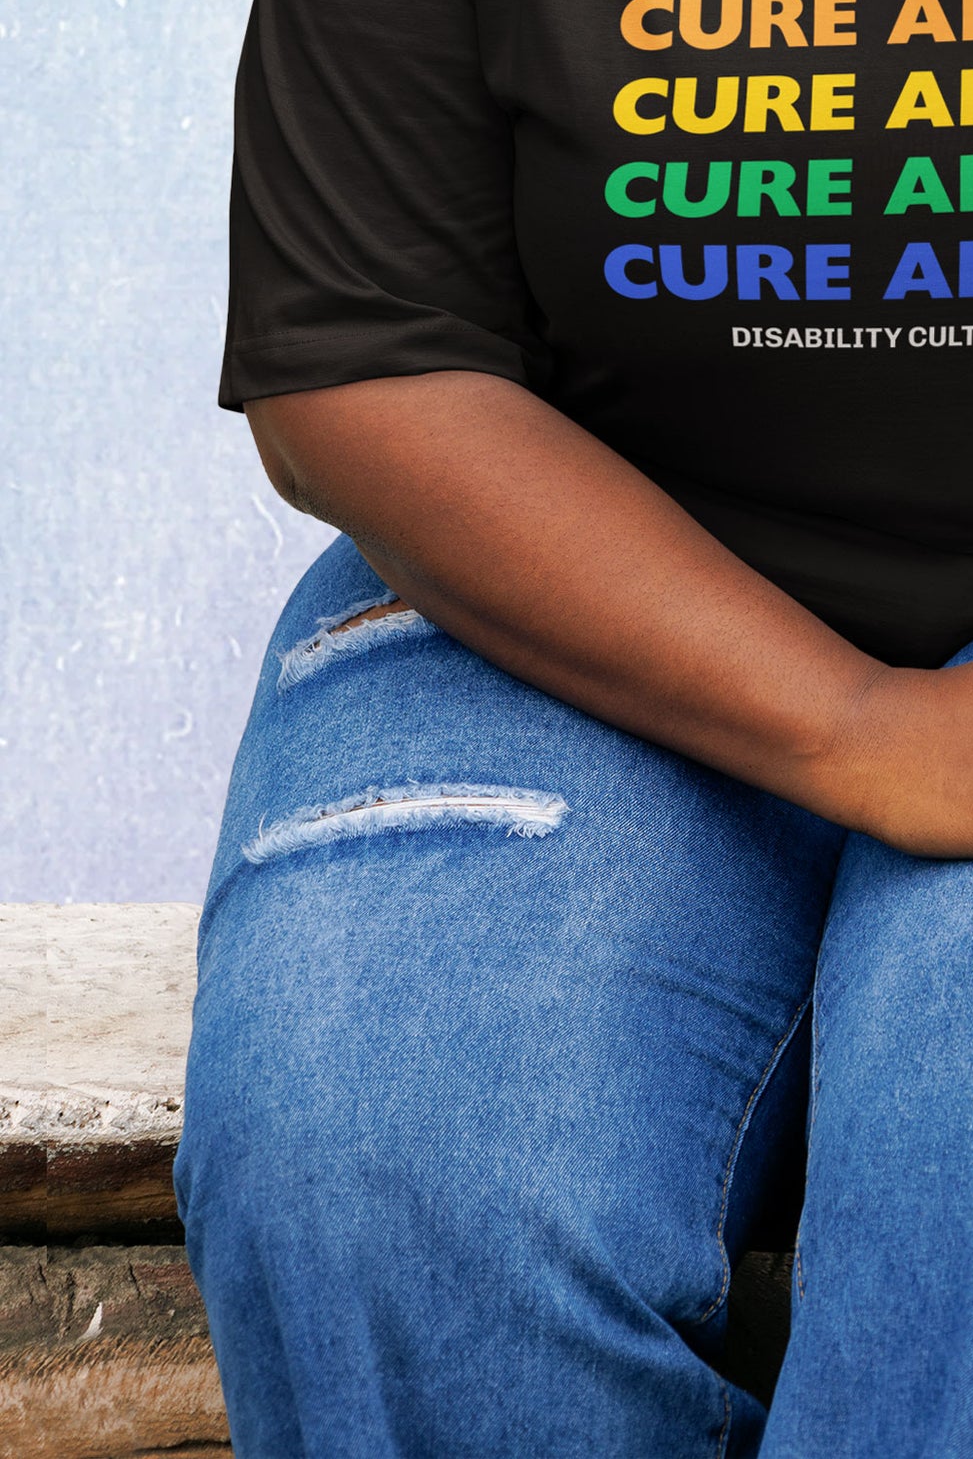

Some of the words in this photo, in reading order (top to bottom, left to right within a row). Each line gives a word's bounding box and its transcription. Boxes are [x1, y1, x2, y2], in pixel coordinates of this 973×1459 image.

[612, 73, 856, 136] CURE
[603, 158, 853, 218] CURE
[603, 243, 852, 301] CURE
[731, 326, 902, 349] DISABILITY
